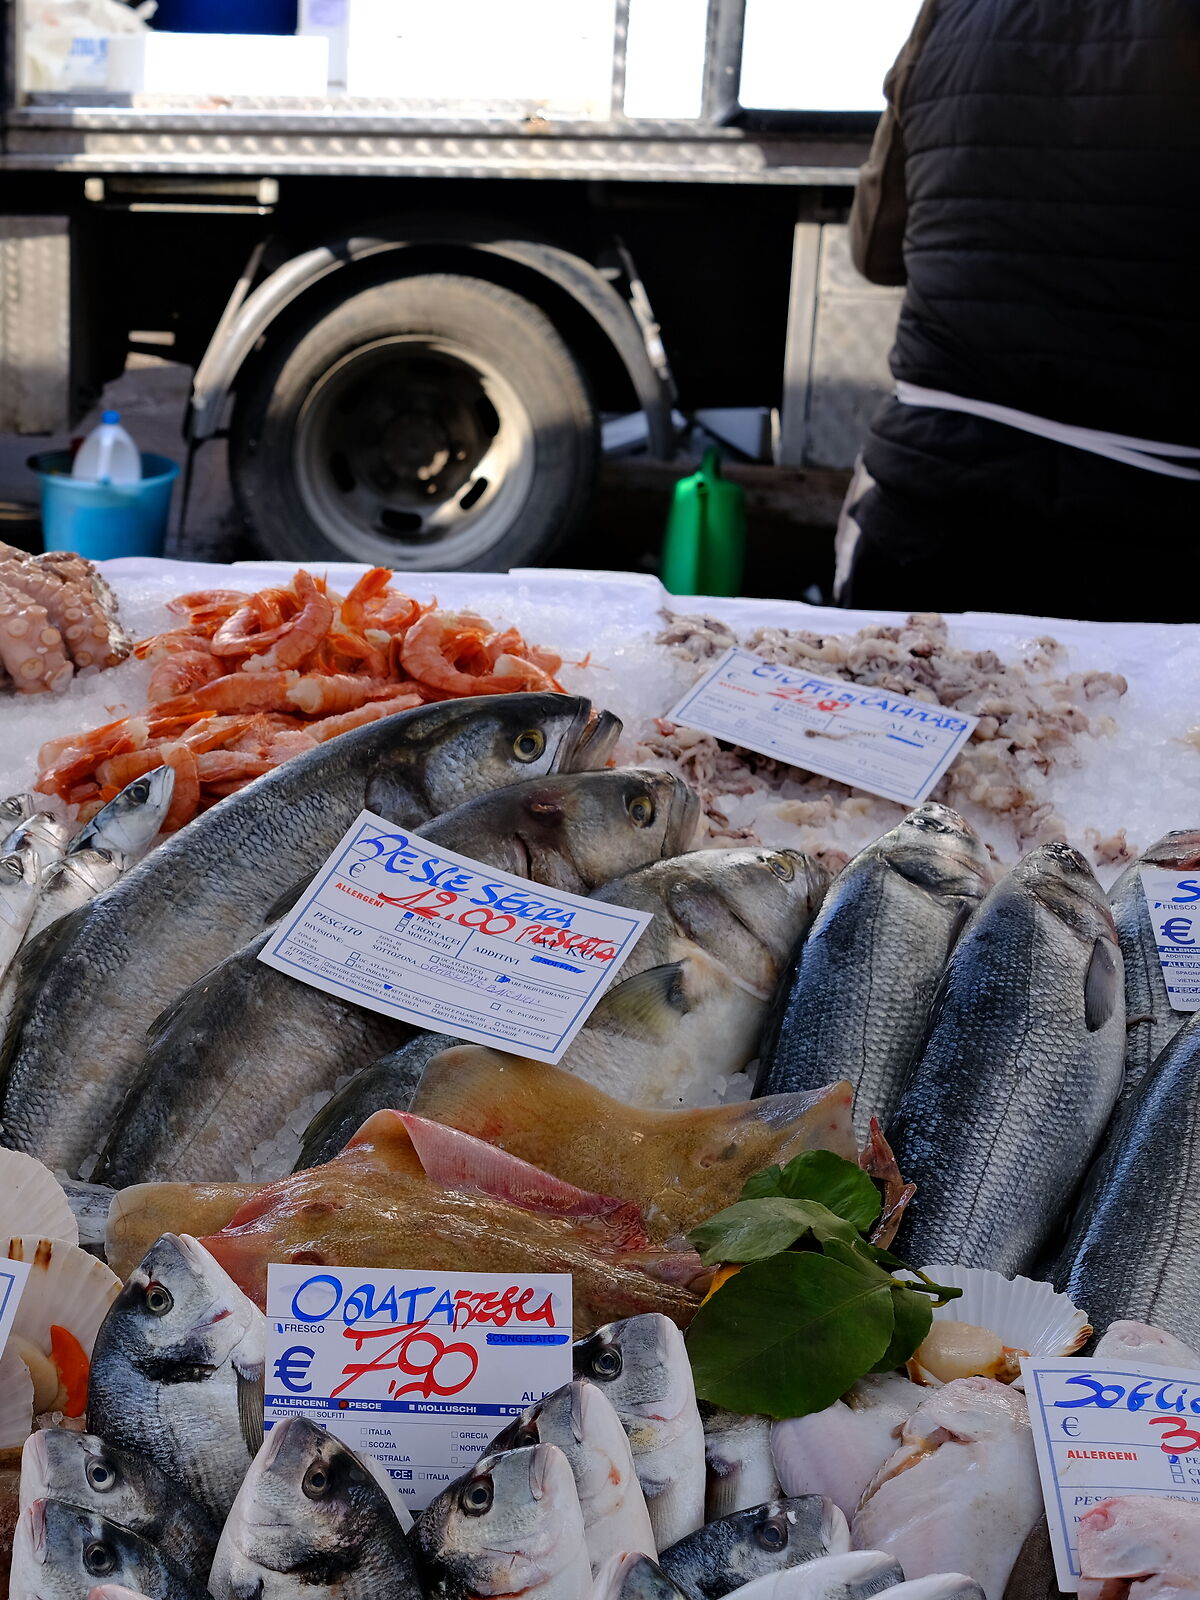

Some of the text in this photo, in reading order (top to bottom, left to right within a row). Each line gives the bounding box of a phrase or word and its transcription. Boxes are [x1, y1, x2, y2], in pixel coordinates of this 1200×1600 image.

[335, 882, 442, 929] ALLERGENI PESCI
[314, 911, 363, 936] PESCATO
[407, 930, 452, 950] MOLLUSCHI
[411, 924, 461, 945] CROSTACEI
[473, 946, 520, 966] ADDITIVI
[372, 944, 417, 965] SOTTOZONA
[284, 1324, 325, 1334] FRESCO
[272, 1398, 477, 1413] ALLERGENI: PESCE MOLLUSCHI
[316, 1411, 345, 1419] SOLFITI
[368, 1428, 392, 1436] ITALIA
[368, 1441, 486, 1452] SCOZIA NORVE
[371, 1454, 411, 1462] USTRALIA
[1067, 1449, 1138, 1461] ALLERGENI
[426, 1473, 450, 1481] ITALIA
